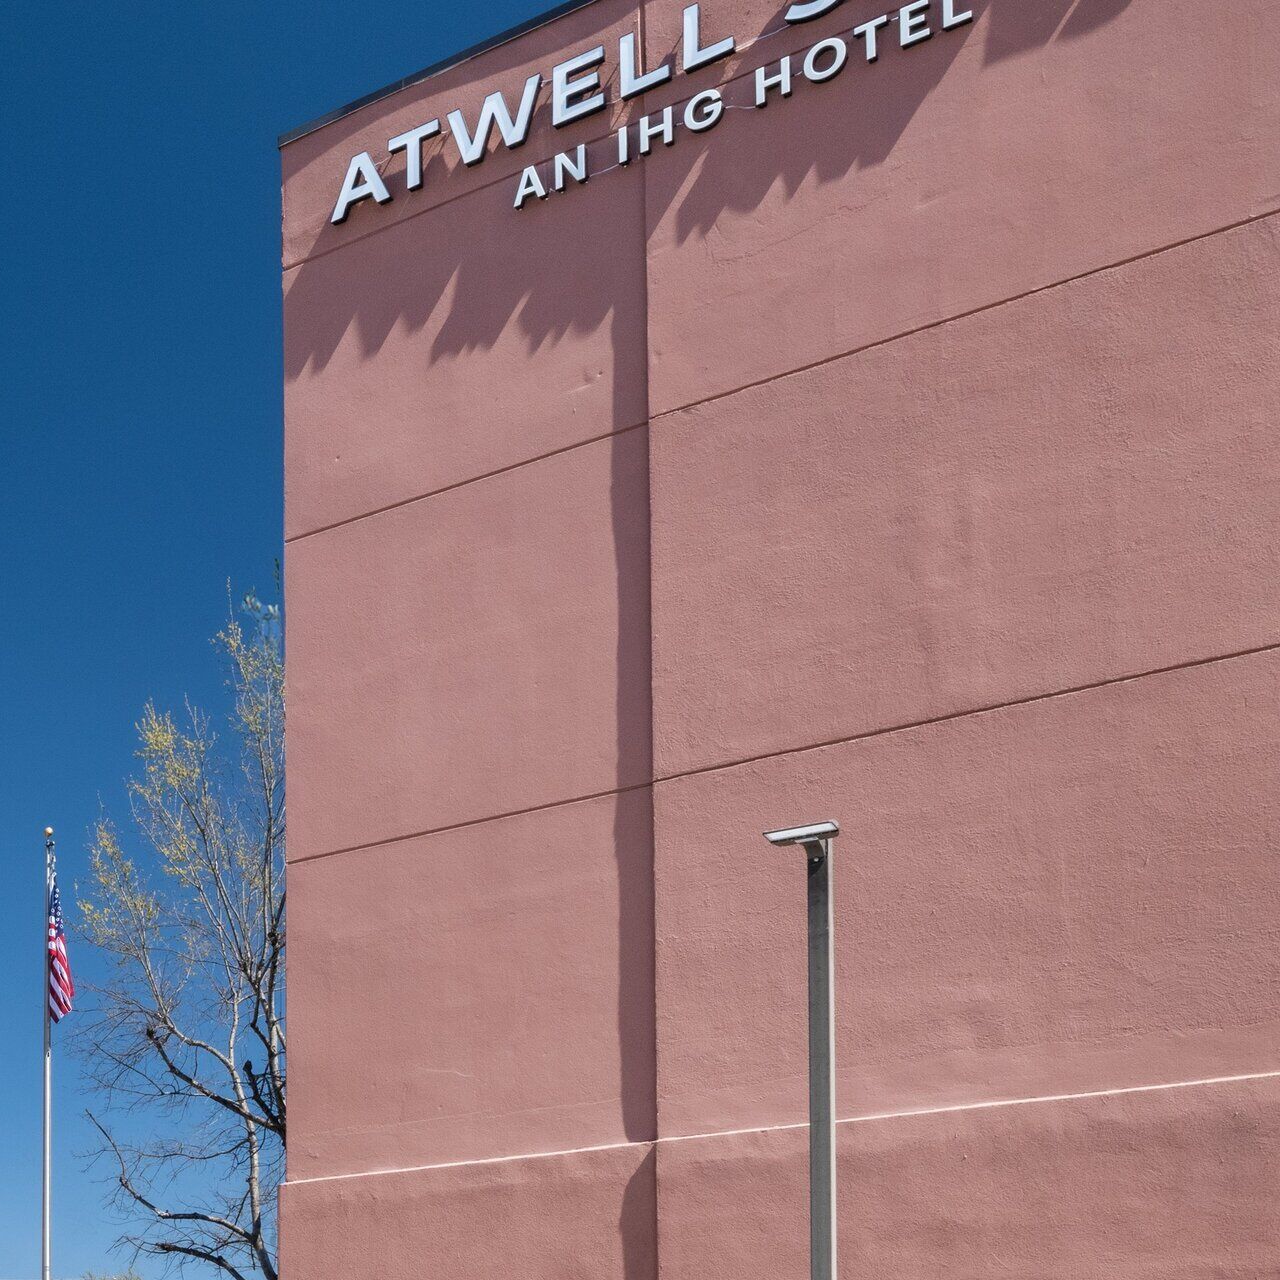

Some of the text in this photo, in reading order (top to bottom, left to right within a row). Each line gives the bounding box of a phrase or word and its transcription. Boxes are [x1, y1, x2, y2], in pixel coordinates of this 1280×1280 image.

[330, 3, 737, 226] ATWELL
[513, 0, 973, 210] AN IHG HOTEL
